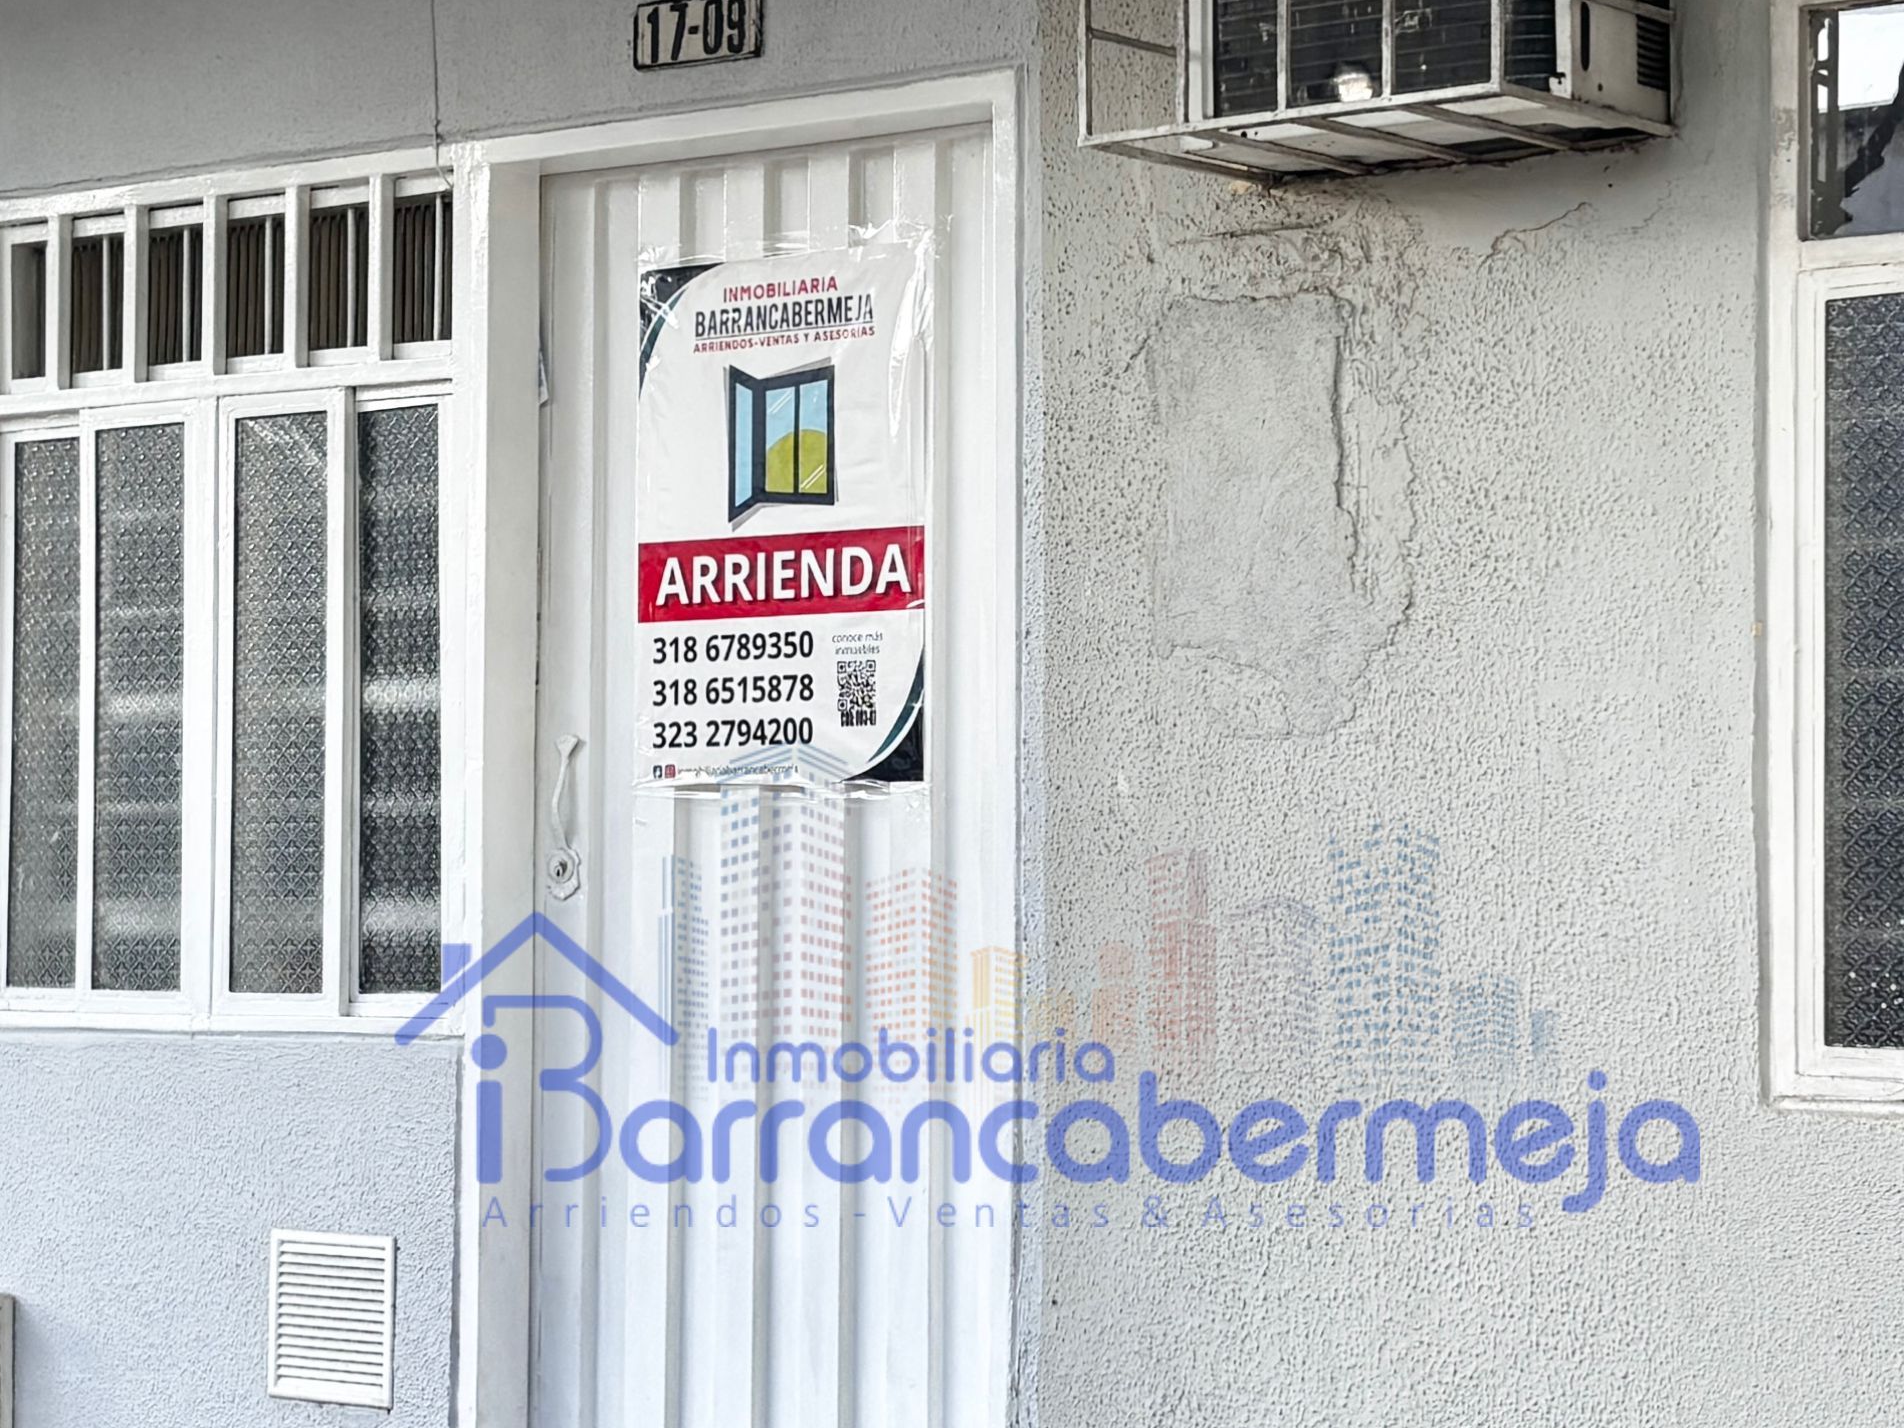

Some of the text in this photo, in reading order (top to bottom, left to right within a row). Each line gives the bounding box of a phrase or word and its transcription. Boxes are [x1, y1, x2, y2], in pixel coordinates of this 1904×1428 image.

[722, 275, 838, 303] INMOBILIARIA
[694, 293, 874, 338] BARRANCABERMEJA
[803, 332, 810, 343] Y
[655, 543, 912, 607] ARRIENDA
[652, 630, 815, 664] 318 6789350
[652, 673, 815, 707] 318 6515878
[652, 717, 814, 750] 323 2794200
